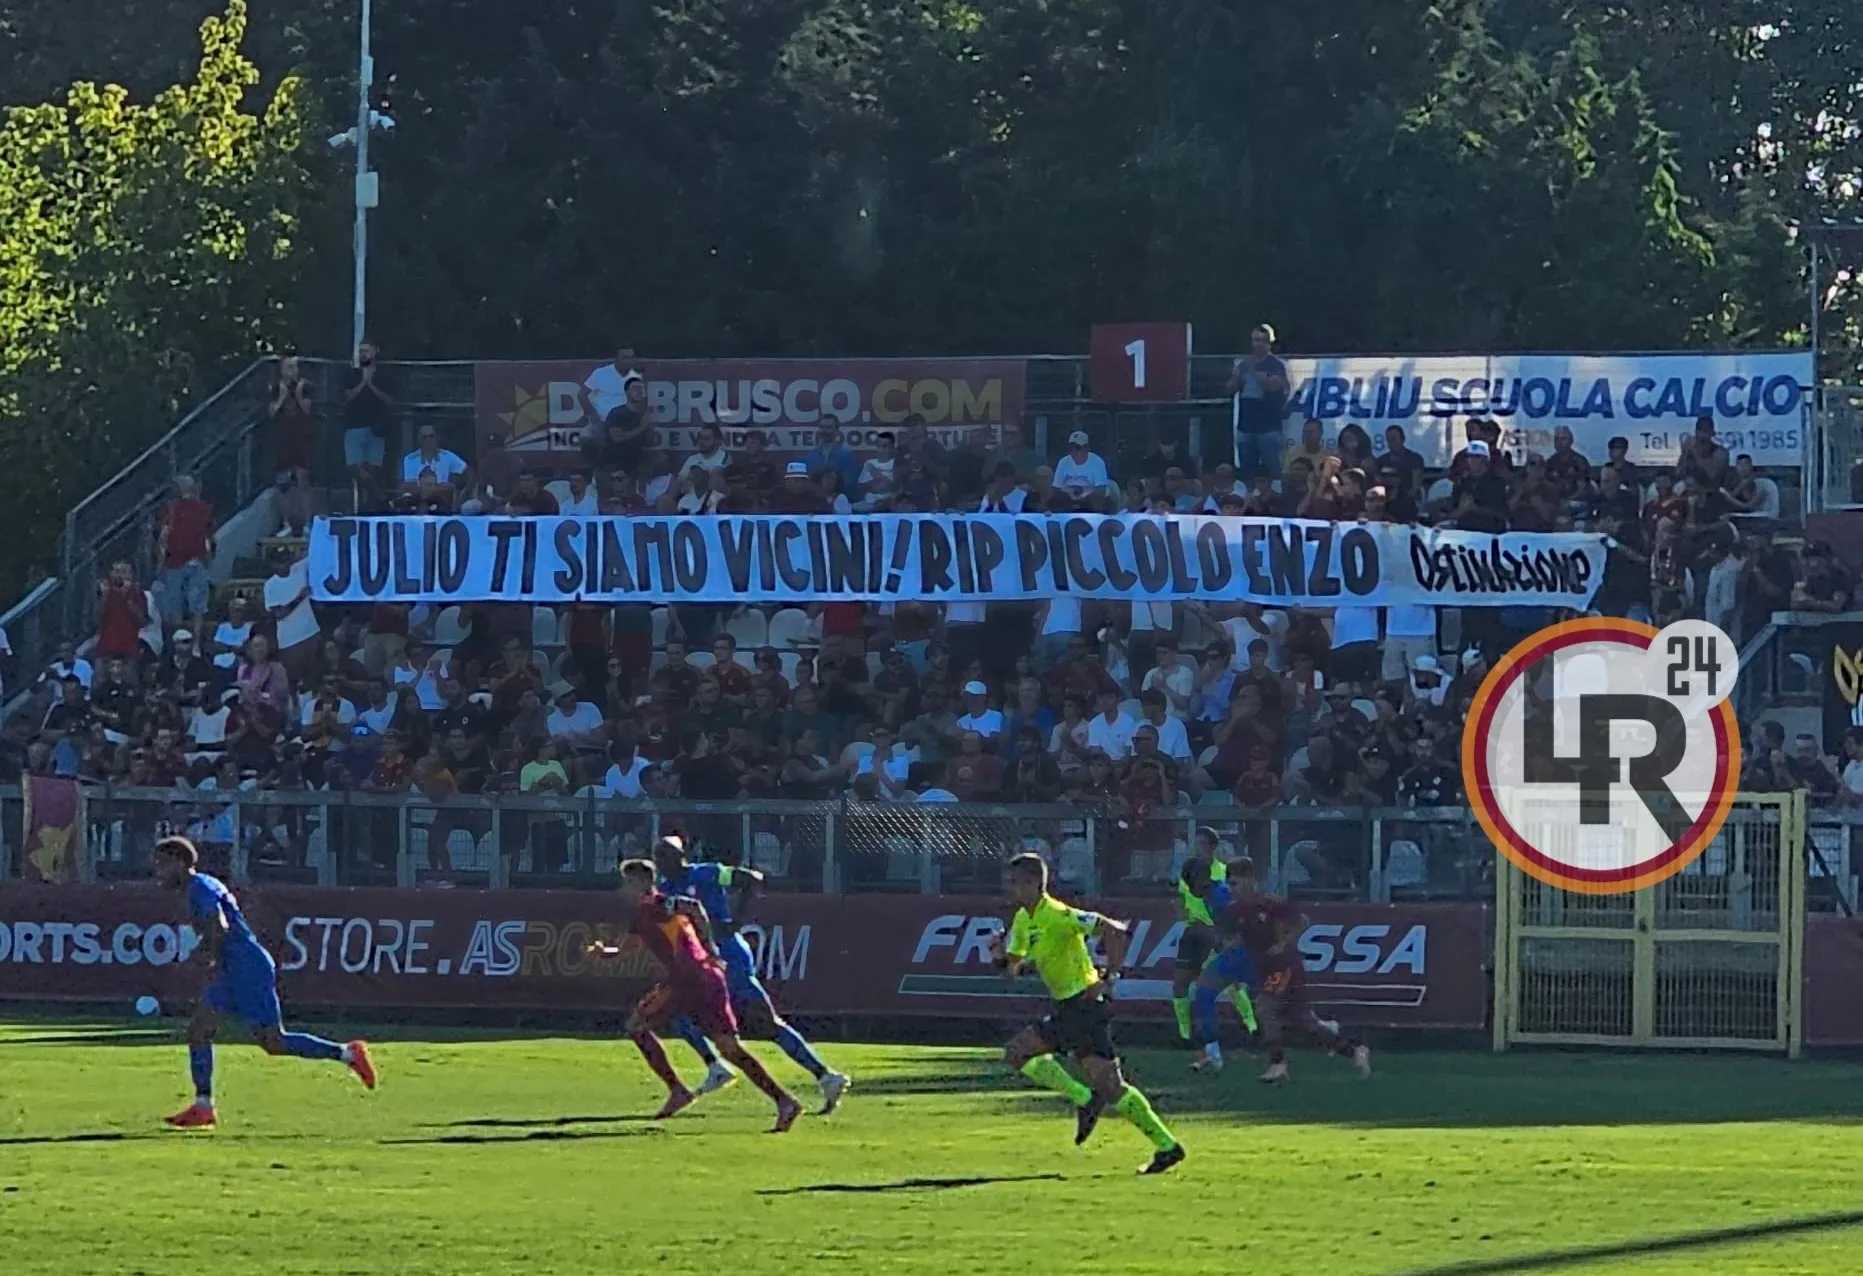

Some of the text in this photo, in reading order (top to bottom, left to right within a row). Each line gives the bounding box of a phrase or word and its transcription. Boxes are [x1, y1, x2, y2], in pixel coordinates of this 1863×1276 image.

[1124, 339, 1146, 389] 1
[1429, 376, 1614, 419] SCUOLA
[1624, 374, 1801, 419] CALCIO
[323, 520, 470, 595] JULIO
[488, 521, 537, 595] TI
[553, 519, 708, 595] SIAMO
[718, 520, 913, 595] VICINI!
[919, 520, 1004, 594] RIP
[1017, 519, 1232, 593] PICCOLO
[1242, 523, 1380, 597] ENZO
